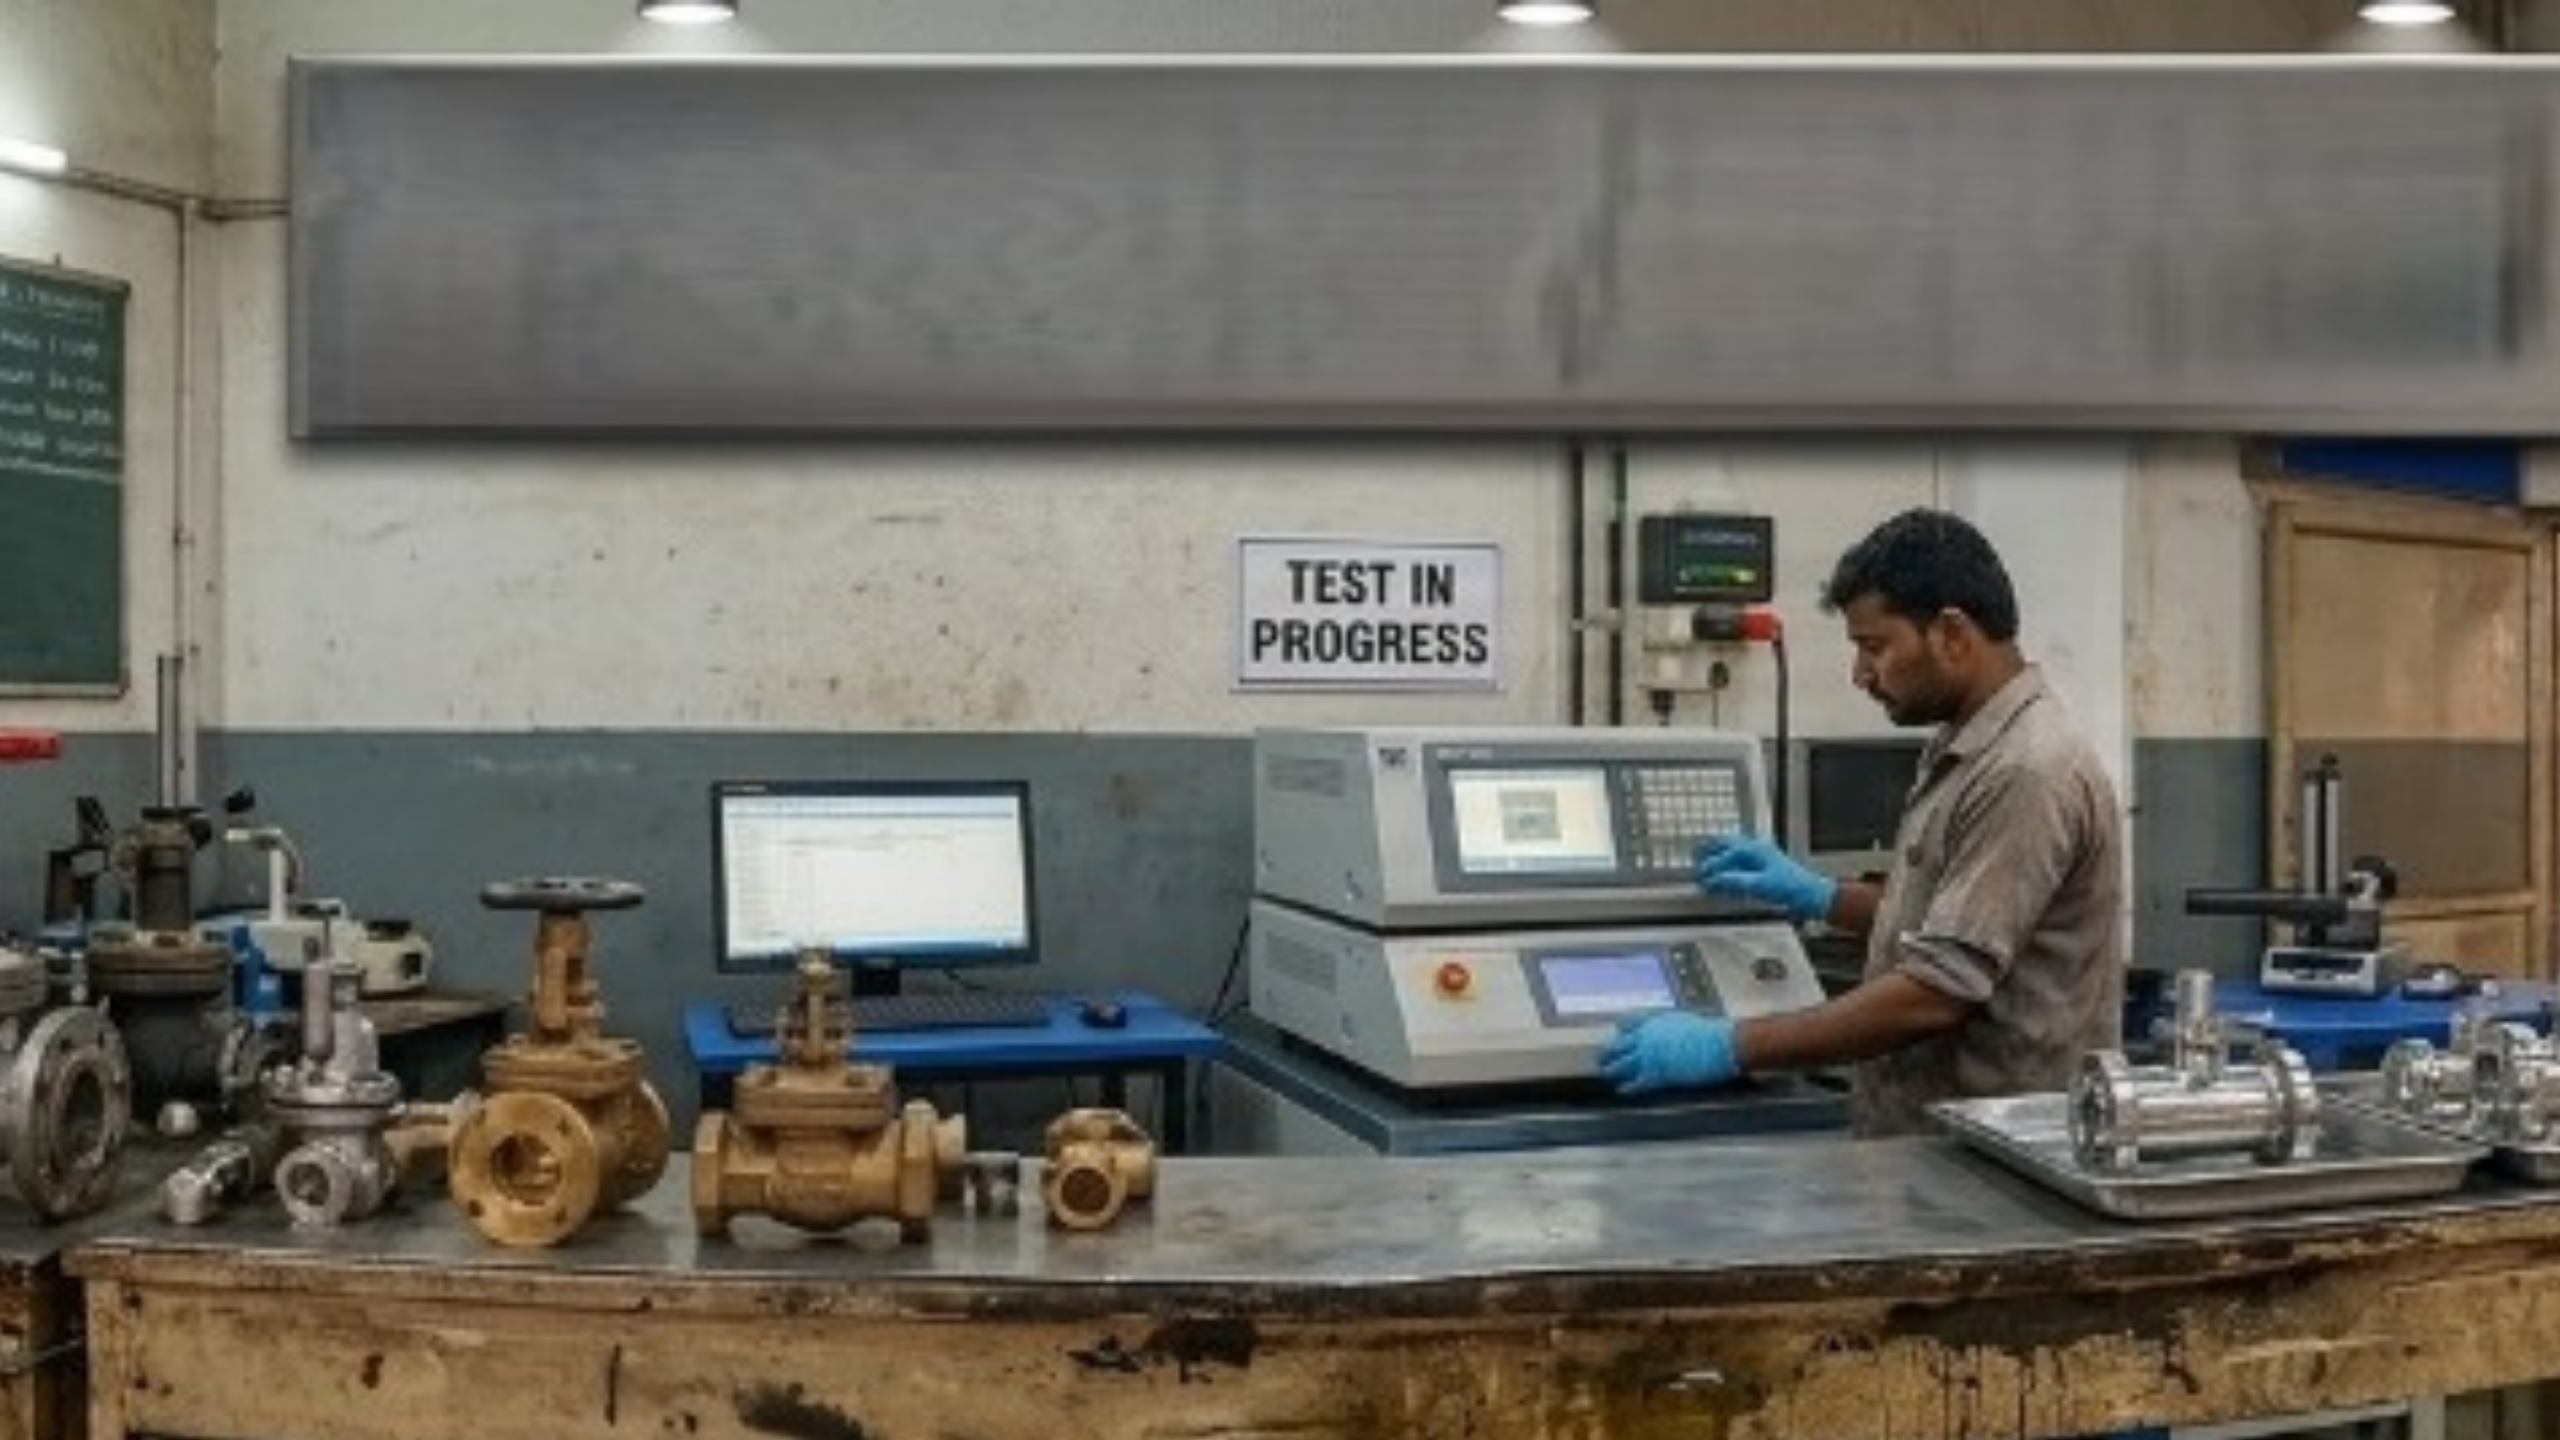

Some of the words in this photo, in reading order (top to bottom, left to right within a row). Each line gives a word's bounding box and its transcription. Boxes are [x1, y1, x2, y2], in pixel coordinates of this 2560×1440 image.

[1286, 560, 1396, 605] TEST
[1411, 564, 1455, 606] IN
[1252, 618, 1489, 664] PROGRESS
